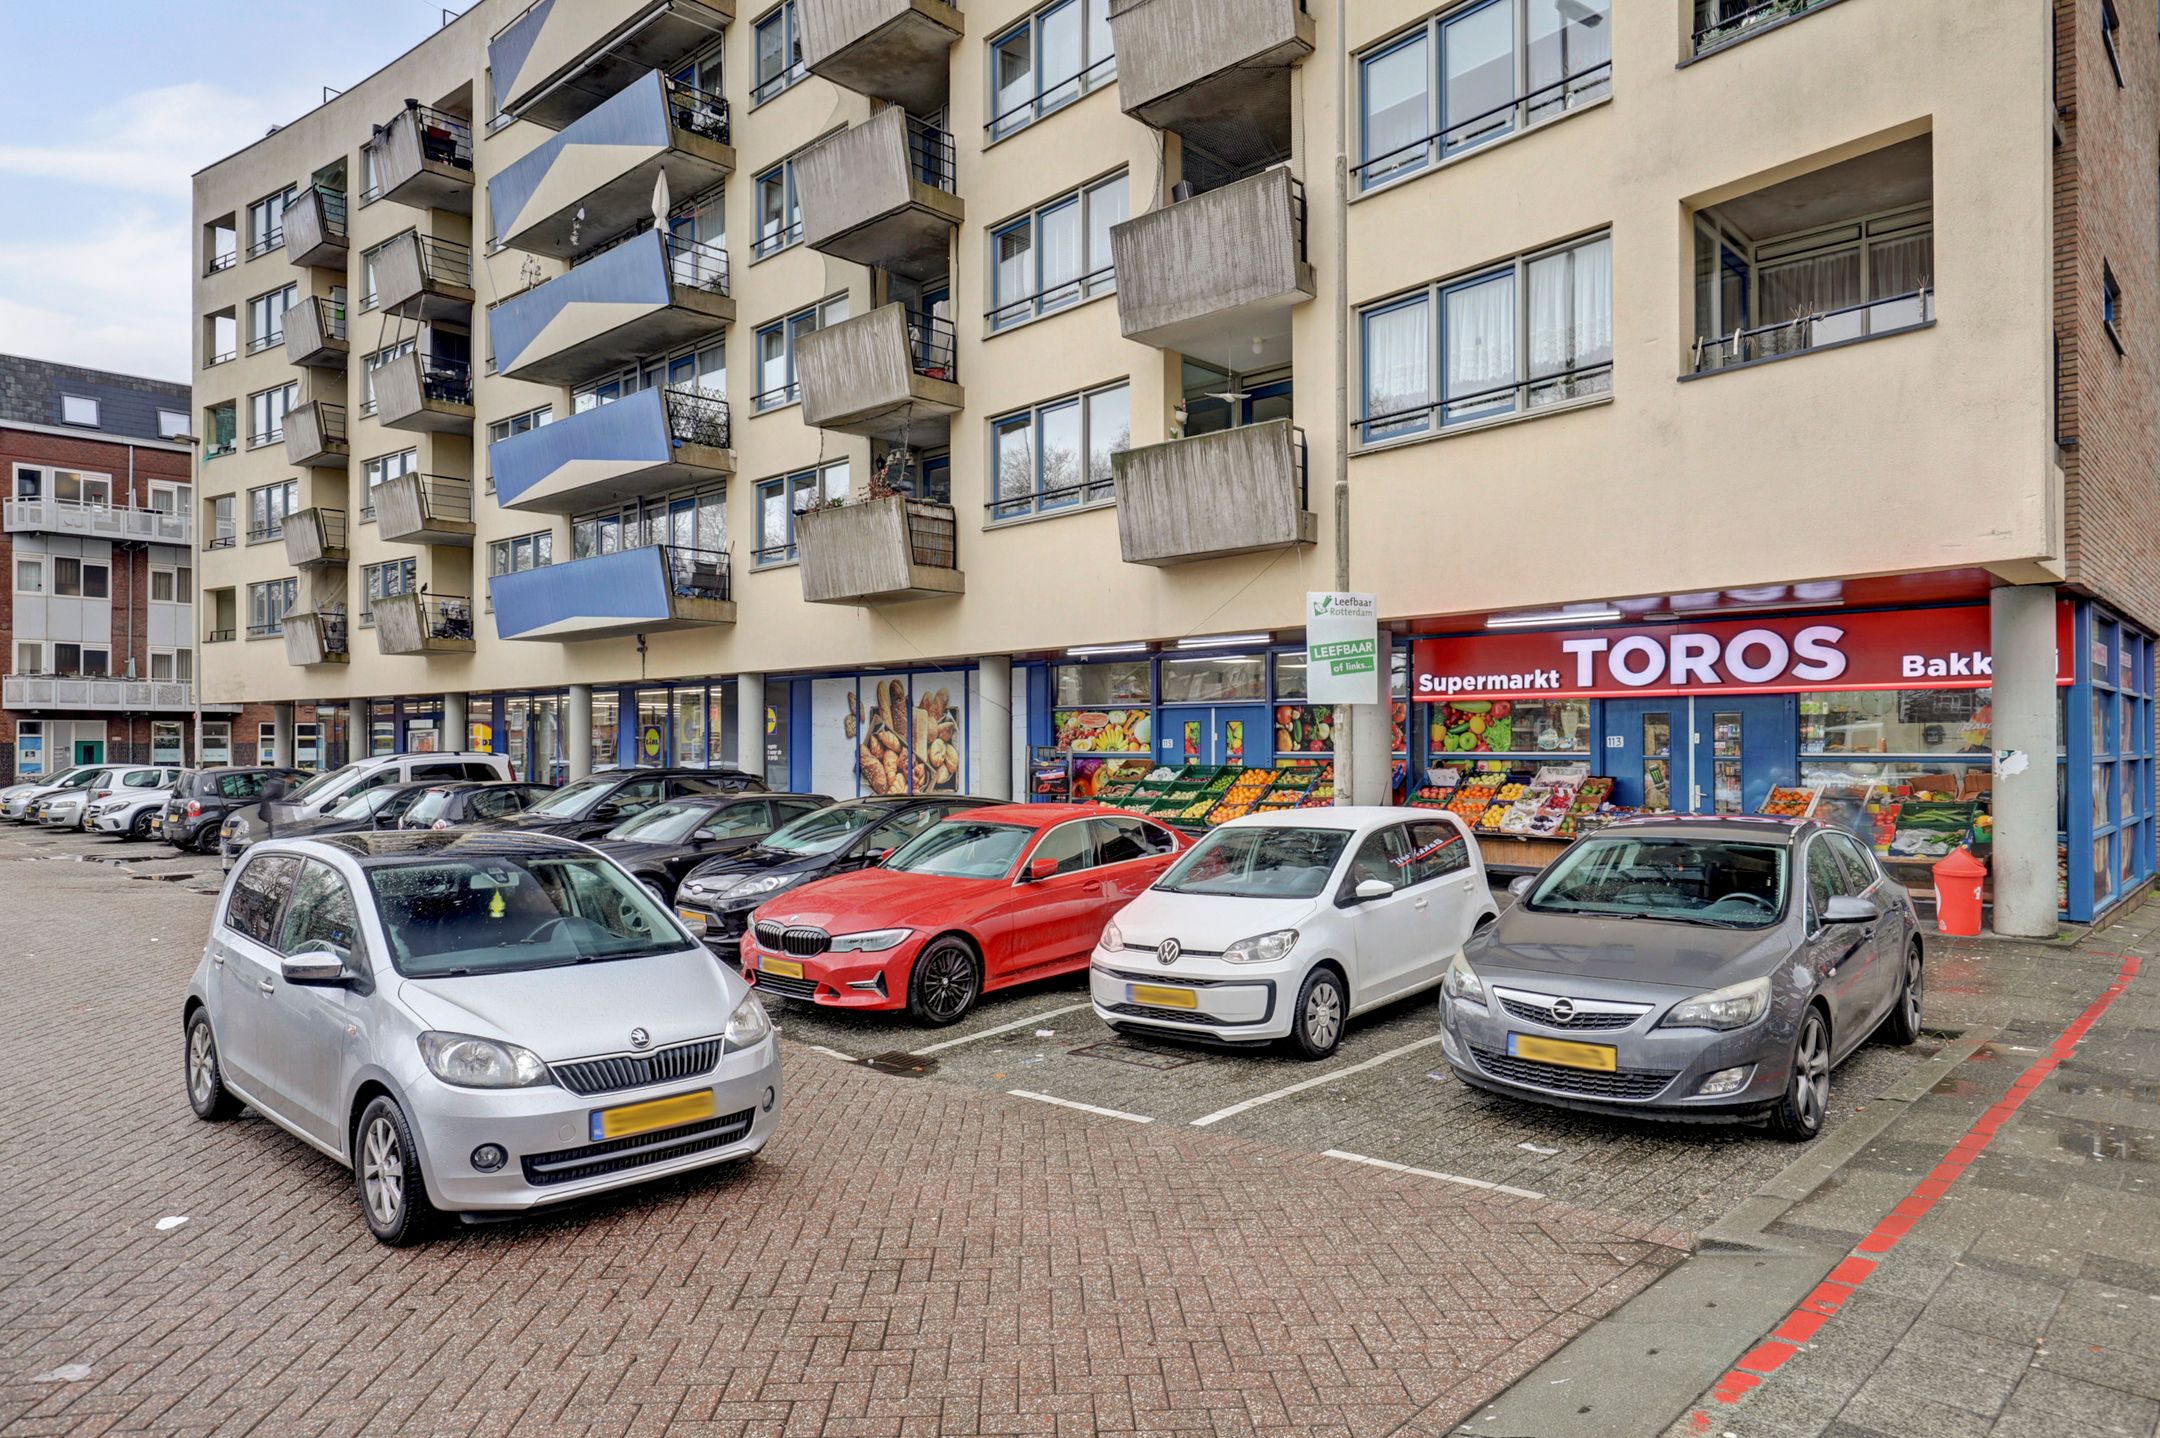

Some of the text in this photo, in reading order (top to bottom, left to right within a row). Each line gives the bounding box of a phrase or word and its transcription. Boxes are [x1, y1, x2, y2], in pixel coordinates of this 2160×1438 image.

[1334, 597, 1372, 607] Leefbaar
[1330, 607, 1373, 617] Rotterdam
[1314, 641, 1373, 659] LEEFBAAR
[1418, 668, 1560, 695] Supermarkt
[1562, 625, 1847, 687] TOROS
[1333, 663, 1343, 673] of
[1608, 736, 1622, 747] 113
